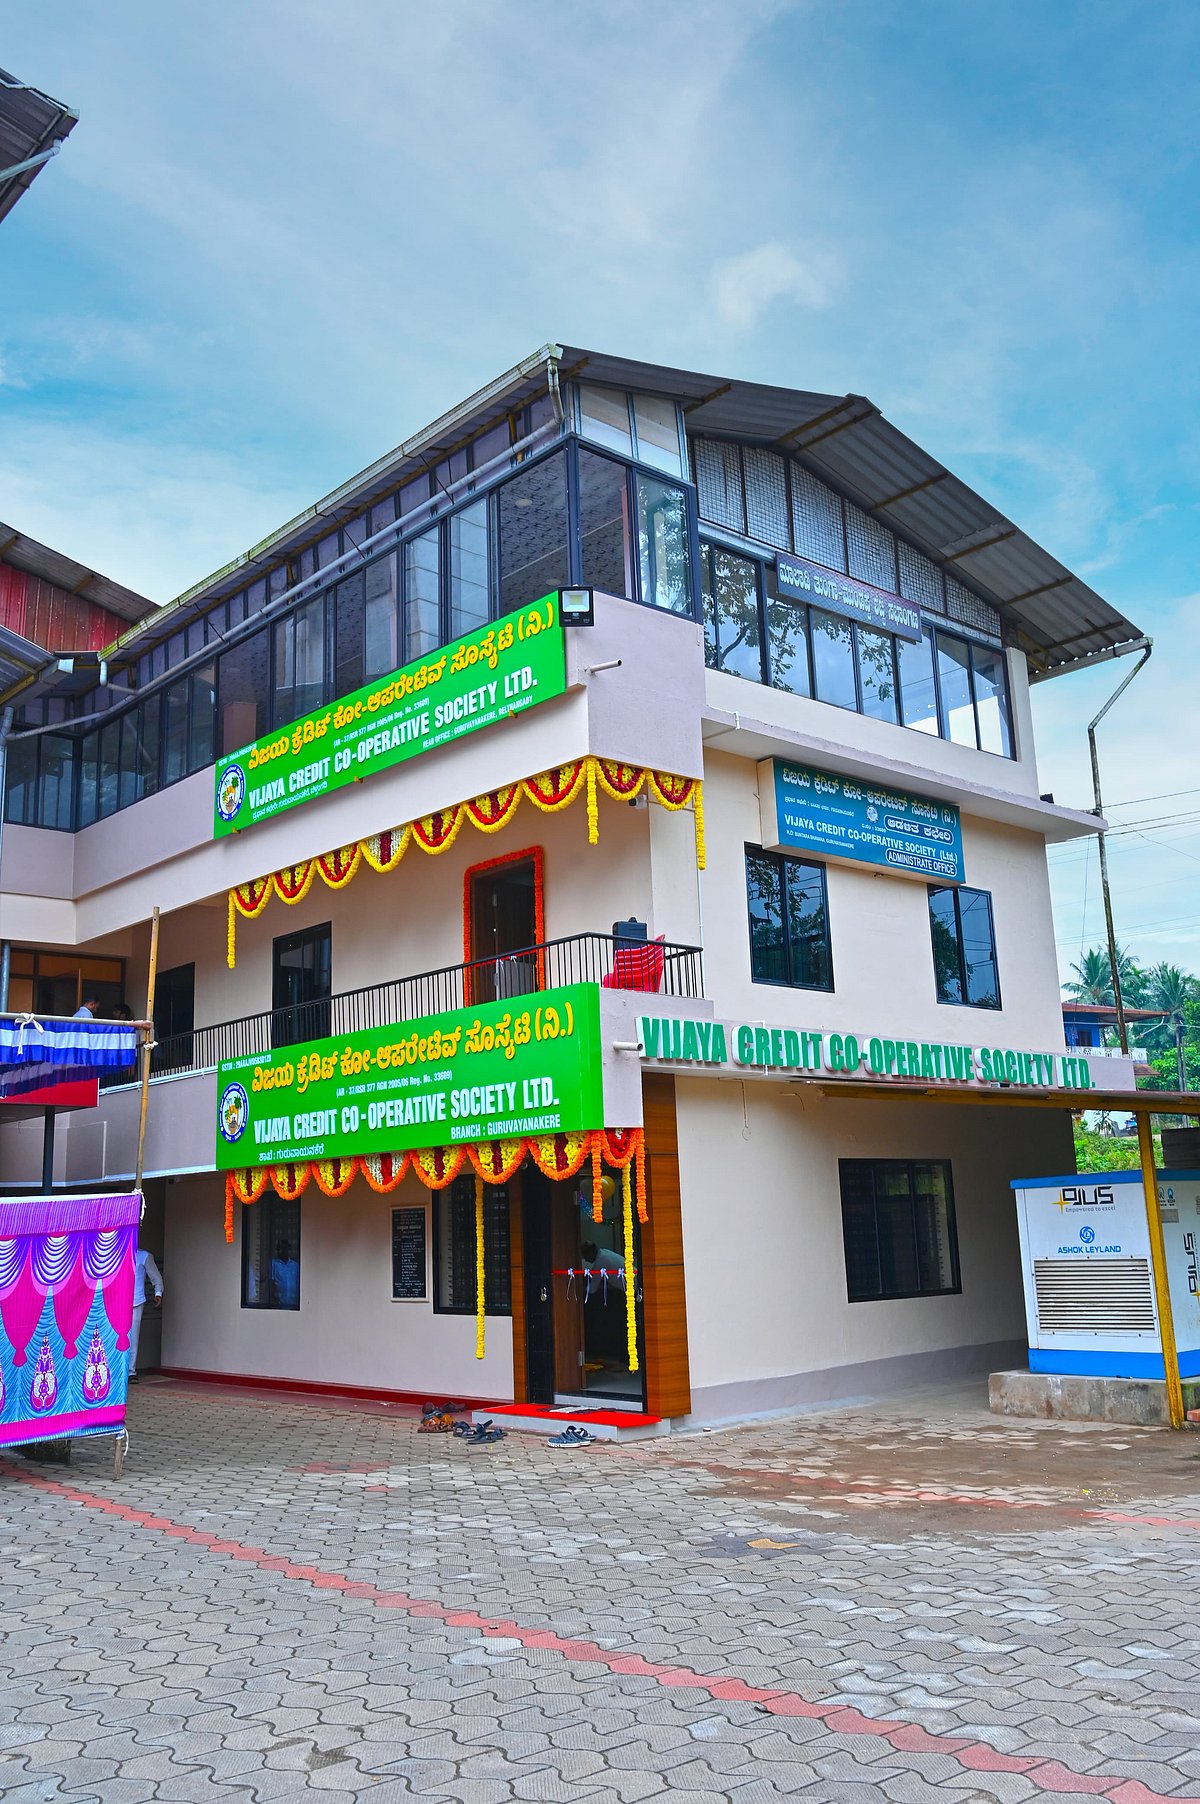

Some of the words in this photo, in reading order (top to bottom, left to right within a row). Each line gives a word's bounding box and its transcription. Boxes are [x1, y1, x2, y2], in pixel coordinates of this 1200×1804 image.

[249, 777, 286, 810] VIJAYA
[289, 756, 331, 793] CREDIT
[334, 711, 430, 773] CO-OPERATIVE
[434, 680, 498, 729] SOCIETY
[504, 666, 538, 699] LTD.
[422, 737, 434, 749] HEAD
[435, 731, 451, 744] OFFICE
[248, 735, 290, 770] ವಿಜಯ
[784, 814, 814, 831] VIJAYA
[816, 821, 846, 838] CREDIT
[847, 828, 904, 851] CO-OPERATIVE
[905, 841, 936, 857] SOCIETY
[940, 850, 958, 864] (Ltd.)
[888, 852, 932, 870] ADMINISTRATE
[933, 861, 955, 875] OFFICE
[640, 1016, 728, 1063] VIJAYA
[735, 1025, 822, 1070] CREDIT
[827, 1033, 974, 1081] CO-OPERATIVE
[978, 1047, 1053, 1086] SOCIETY
[1059, 1056, 1096, 1089] LTD.
[252, 1062, 294, 1092] ವಿಜಯ
[366, 1082, 376, 1092] 377
[388, 1077, 409, 1089] 2005/06
[409, 1075, 422, 1086] Reg.
[423, 1073, 432, 1083] No.
[253, 1116, 292, 1145] VIJAYA
[293, 1109, 338, 1140] CREDIT
[450, 1081, 517, 1119] SOCIETY
[522, 1076, 560, 1110] LTD.
[451, 1124, 481, 1140] BRANCH
[487, 1113, 561, 1135] GURUVAYANAKERE
[1065, 1205, 1094, 1213] Empowered
[1057, 1246, 1084, 1255] ASHOK
[1085, 1245, 1122, 1254] LEYLAND
